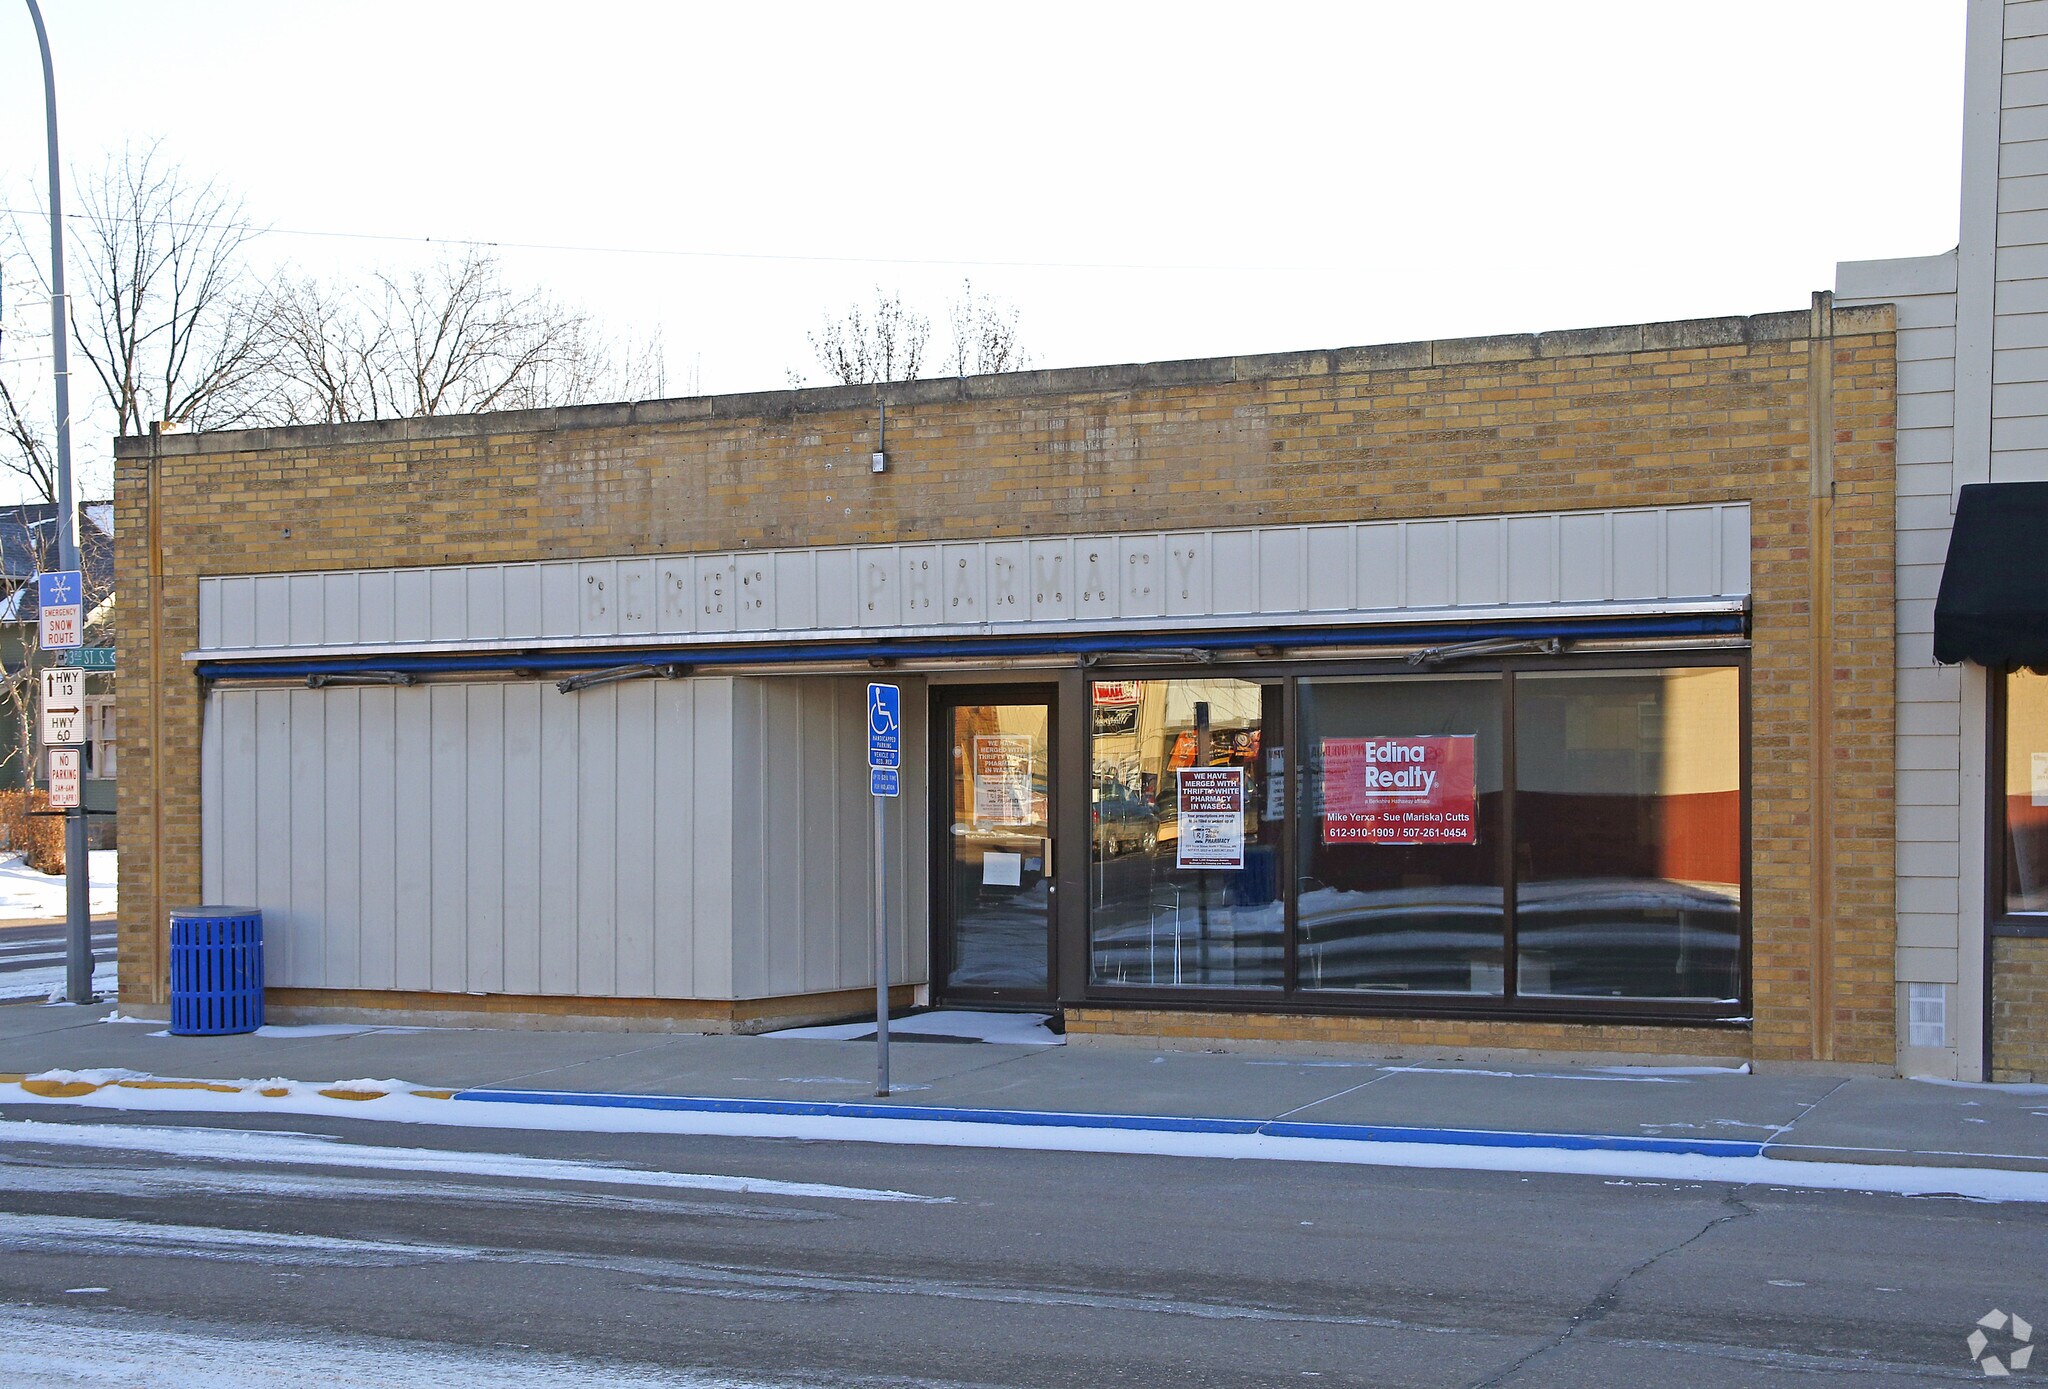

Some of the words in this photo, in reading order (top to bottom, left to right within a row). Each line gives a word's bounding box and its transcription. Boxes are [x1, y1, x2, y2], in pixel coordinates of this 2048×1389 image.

[867, 548, 1196, 610] PHARMACY
[45, 608, 76, 617] EMERGENCY
[50, 620, 72, 631] SNOW
[48, 633, 74, 644] ROUTE
[56, 672, 78, 683] HWY
[62, 685, 73, 695] 13
[52, 718, 74, 728] HWY
[57, 730, 70, 740] 60
[1366, 742, 1424, 762] Edina
[59, 756, 69, 766] NO
[52, 769, 76, 779] PARKING
[1366, 766, 1436, 795] Realty
[1327, 813, 1348, 821] Mike
[1350, 813, 1375, 821] Yerxa
[1383, 813, 1400, 821] Sue
[1403, 813, 1442, 823] (Mariska)
[1446, 813, 1470, 821] Cutts
[1330, 828, 1394, 837] 612-910-1909
[1403, 828, 1467, 837] 507-261-0454
